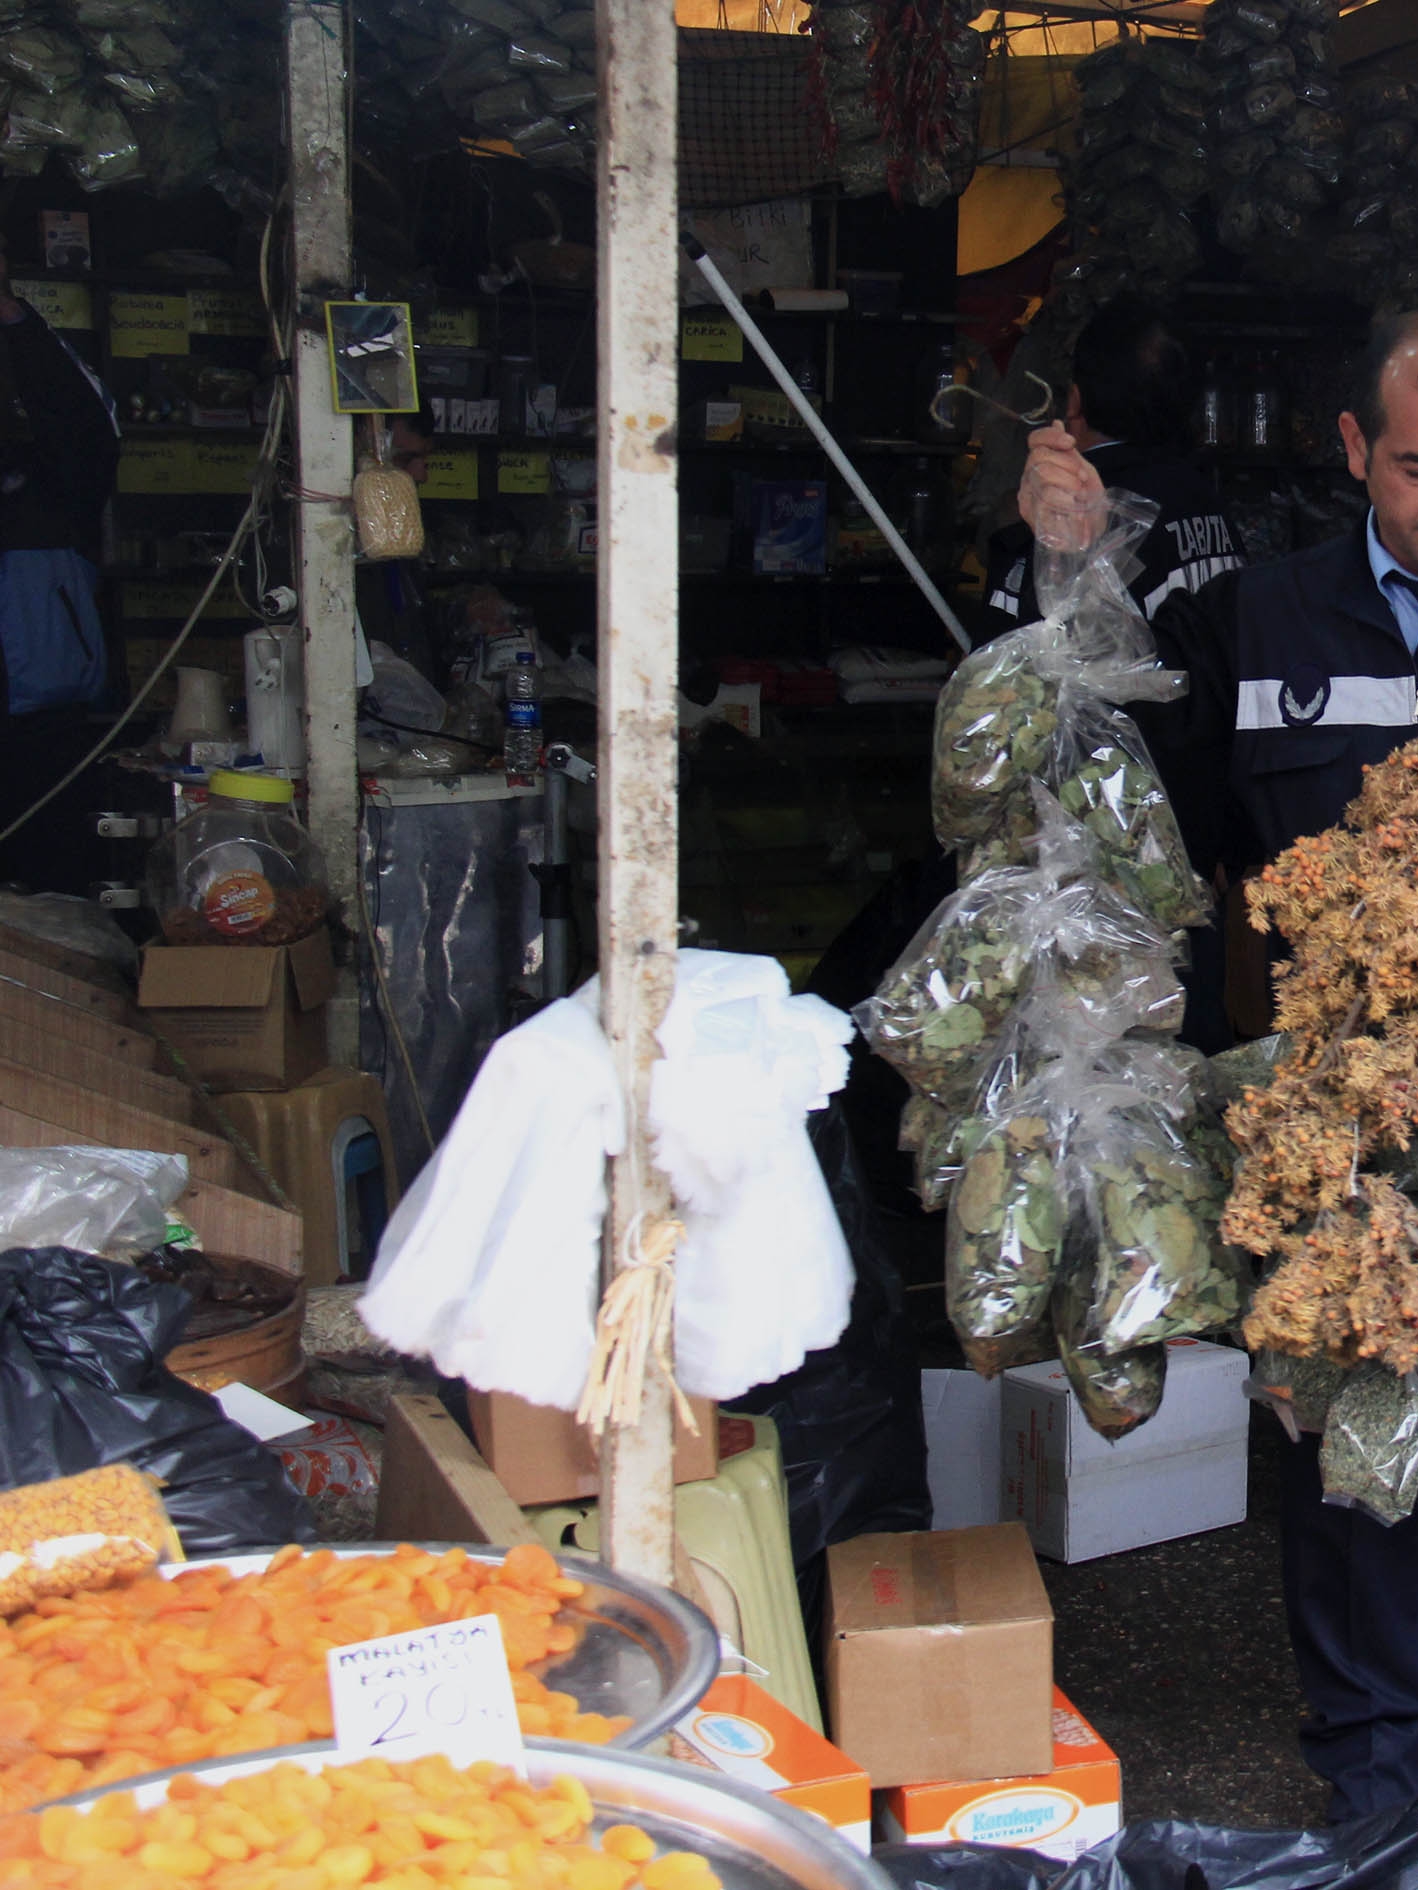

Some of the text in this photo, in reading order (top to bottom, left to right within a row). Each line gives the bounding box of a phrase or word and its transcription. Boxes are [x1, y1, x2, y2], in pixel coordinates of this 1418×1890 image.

[1164, 515, 1234, 561] ZABITA
[509, 702, 536, 713] SIRMA
[220, 887, 259, 908] Sincap
[369, 1683, 469, 1747] 20
[972, 1804, 1055, 1834] Karakaya
